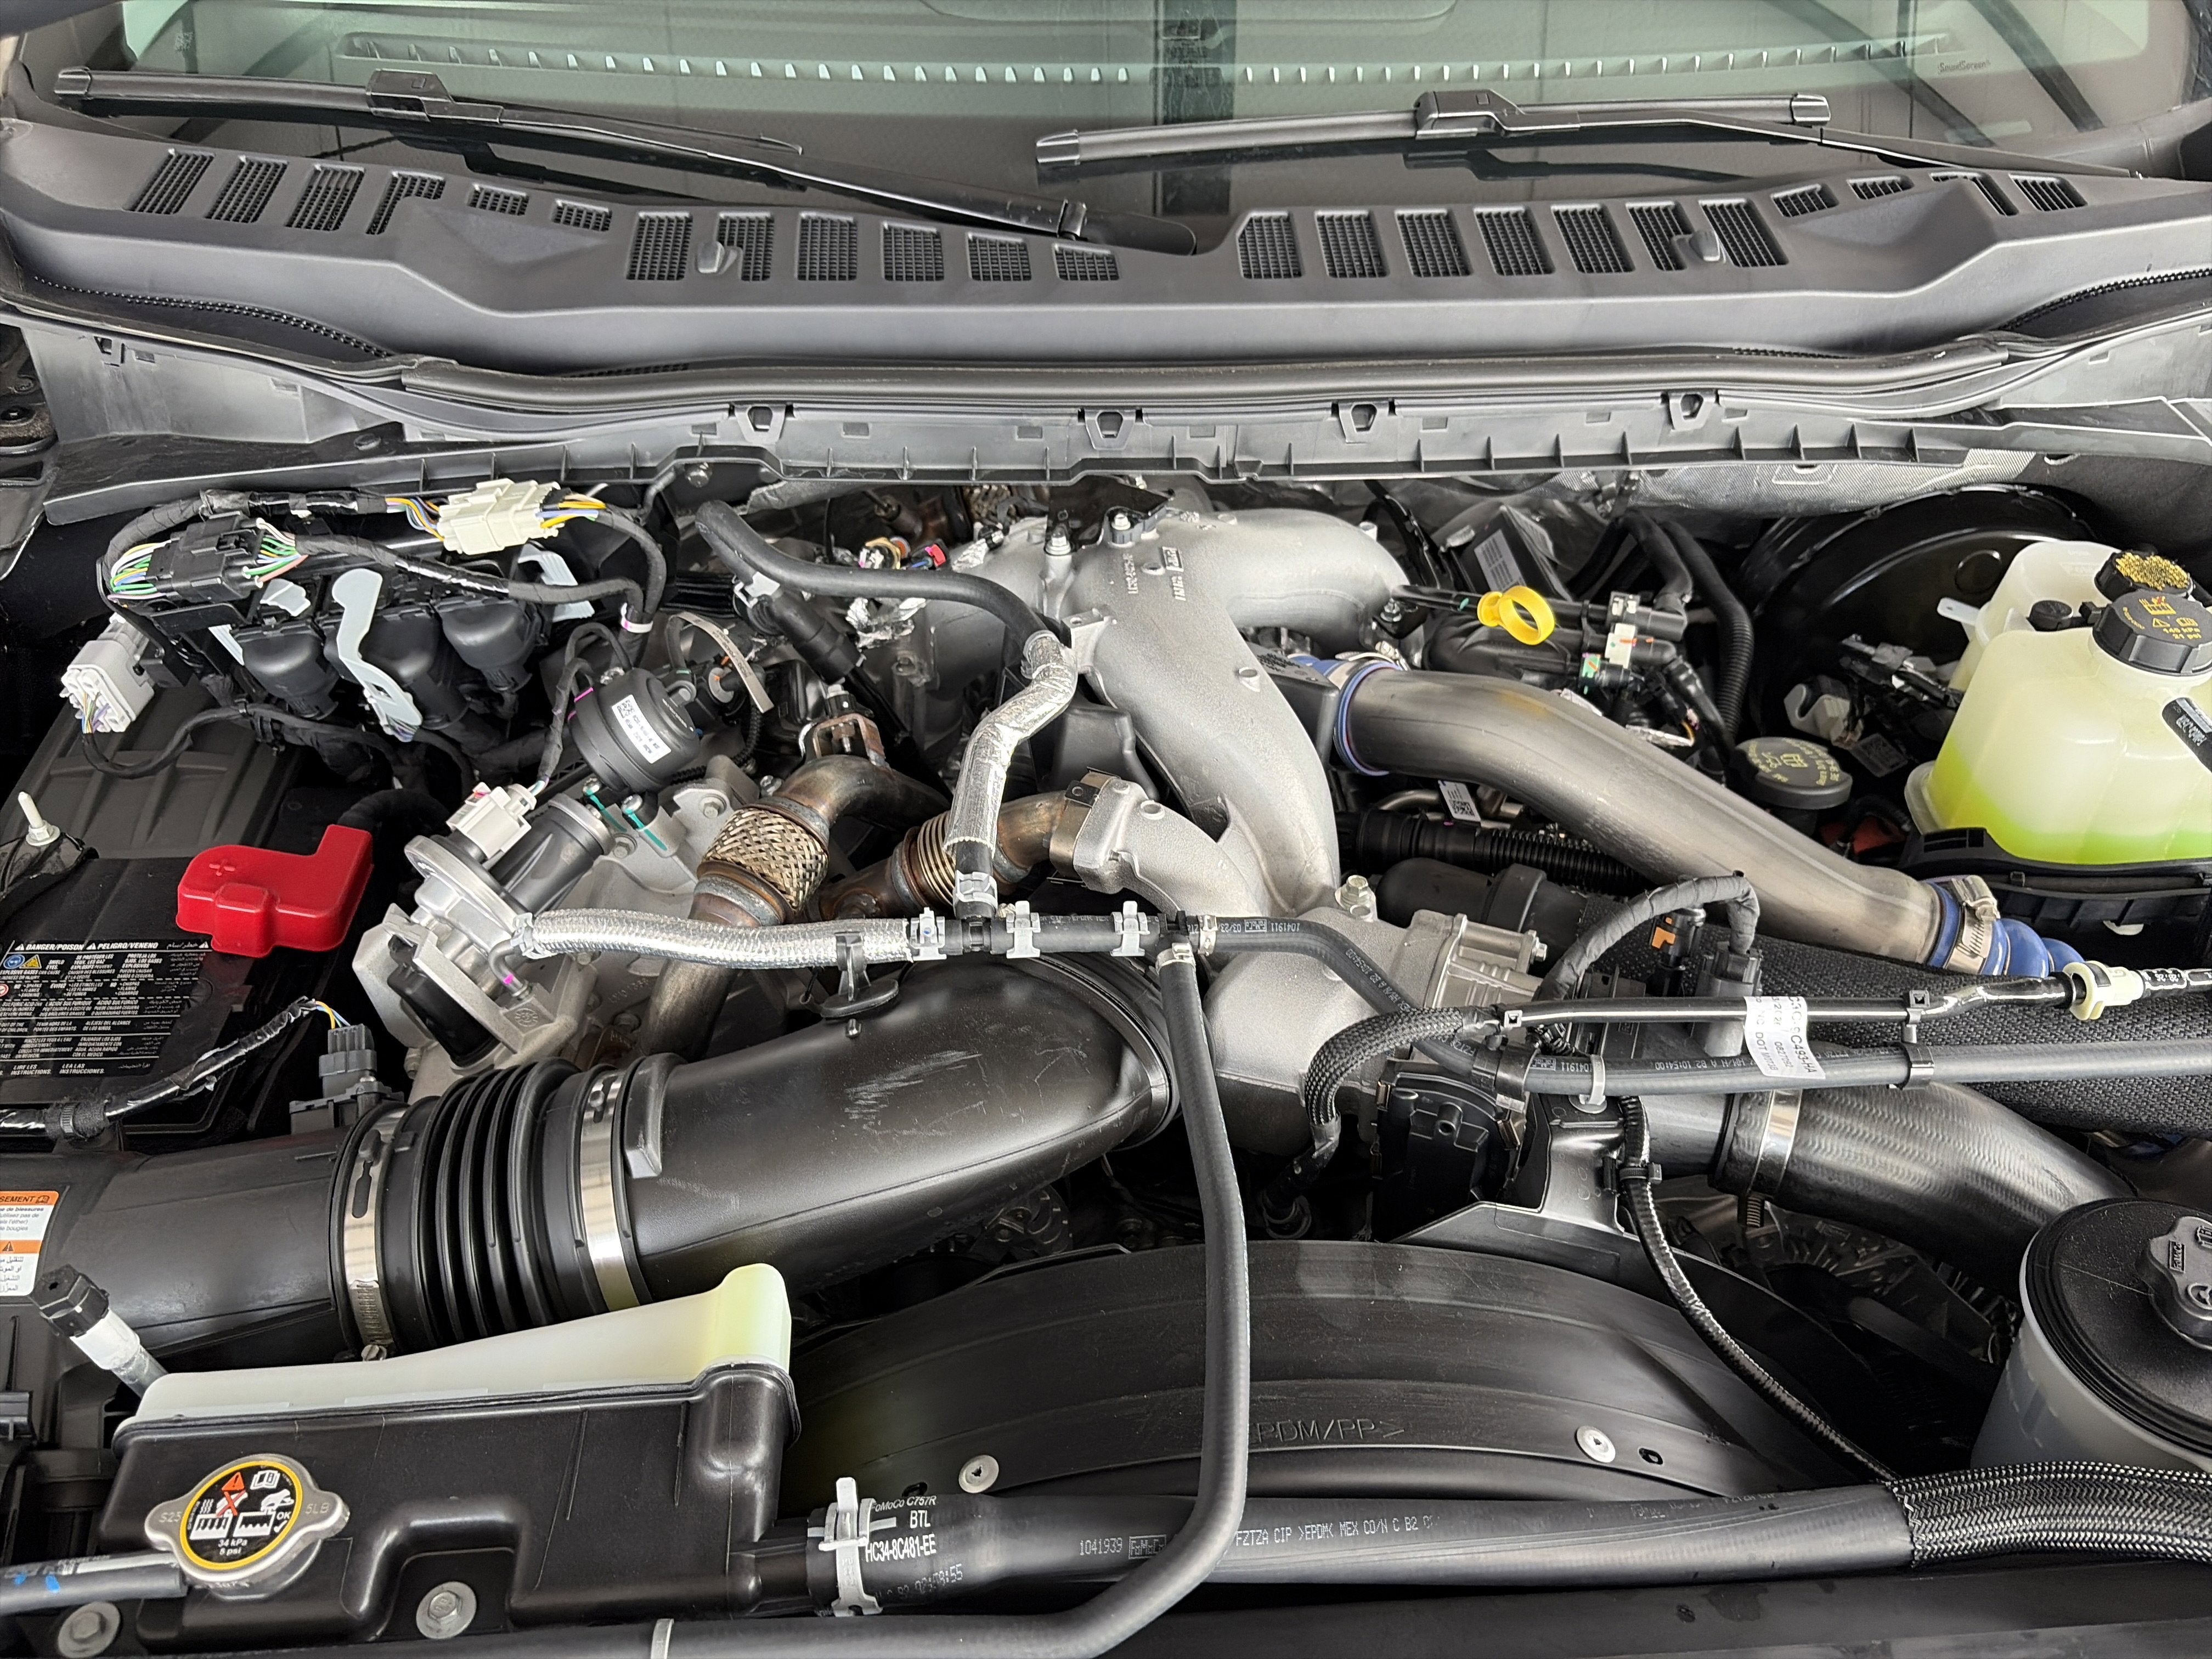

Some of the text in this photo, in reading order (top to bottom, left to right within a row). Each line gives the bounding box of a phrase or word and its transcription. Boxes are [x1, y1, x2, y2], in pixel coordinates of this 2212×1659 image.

[1270, 922, 1301, 932] 1041911
[1756, 1032, 1768, 1051] DOT
[1531, 1056, 1556, 1071] FoMoC
[1250, 1418, 1404, 1443] PDM/PP>
[906, 1495, 938, 1506] C757R
[276, 1510, 292, 1521] OK
[910, 1510, 932, 1529] BTL
[218, 1538, 248, 1548] 34 kPa
[1079, 1537, 1123, 1556] 1041939
[1273, 1527, 1293, 1543] CIP
[1339, 1521, 1359, 1537] MEX
[1392, 1518, 1400, 1532] C
[1404, 1516, 1419, 1531] B2
[227, 1548, 241, 1556] psi
[865, 1533, 937, 1562] HC34-8C481-EE
